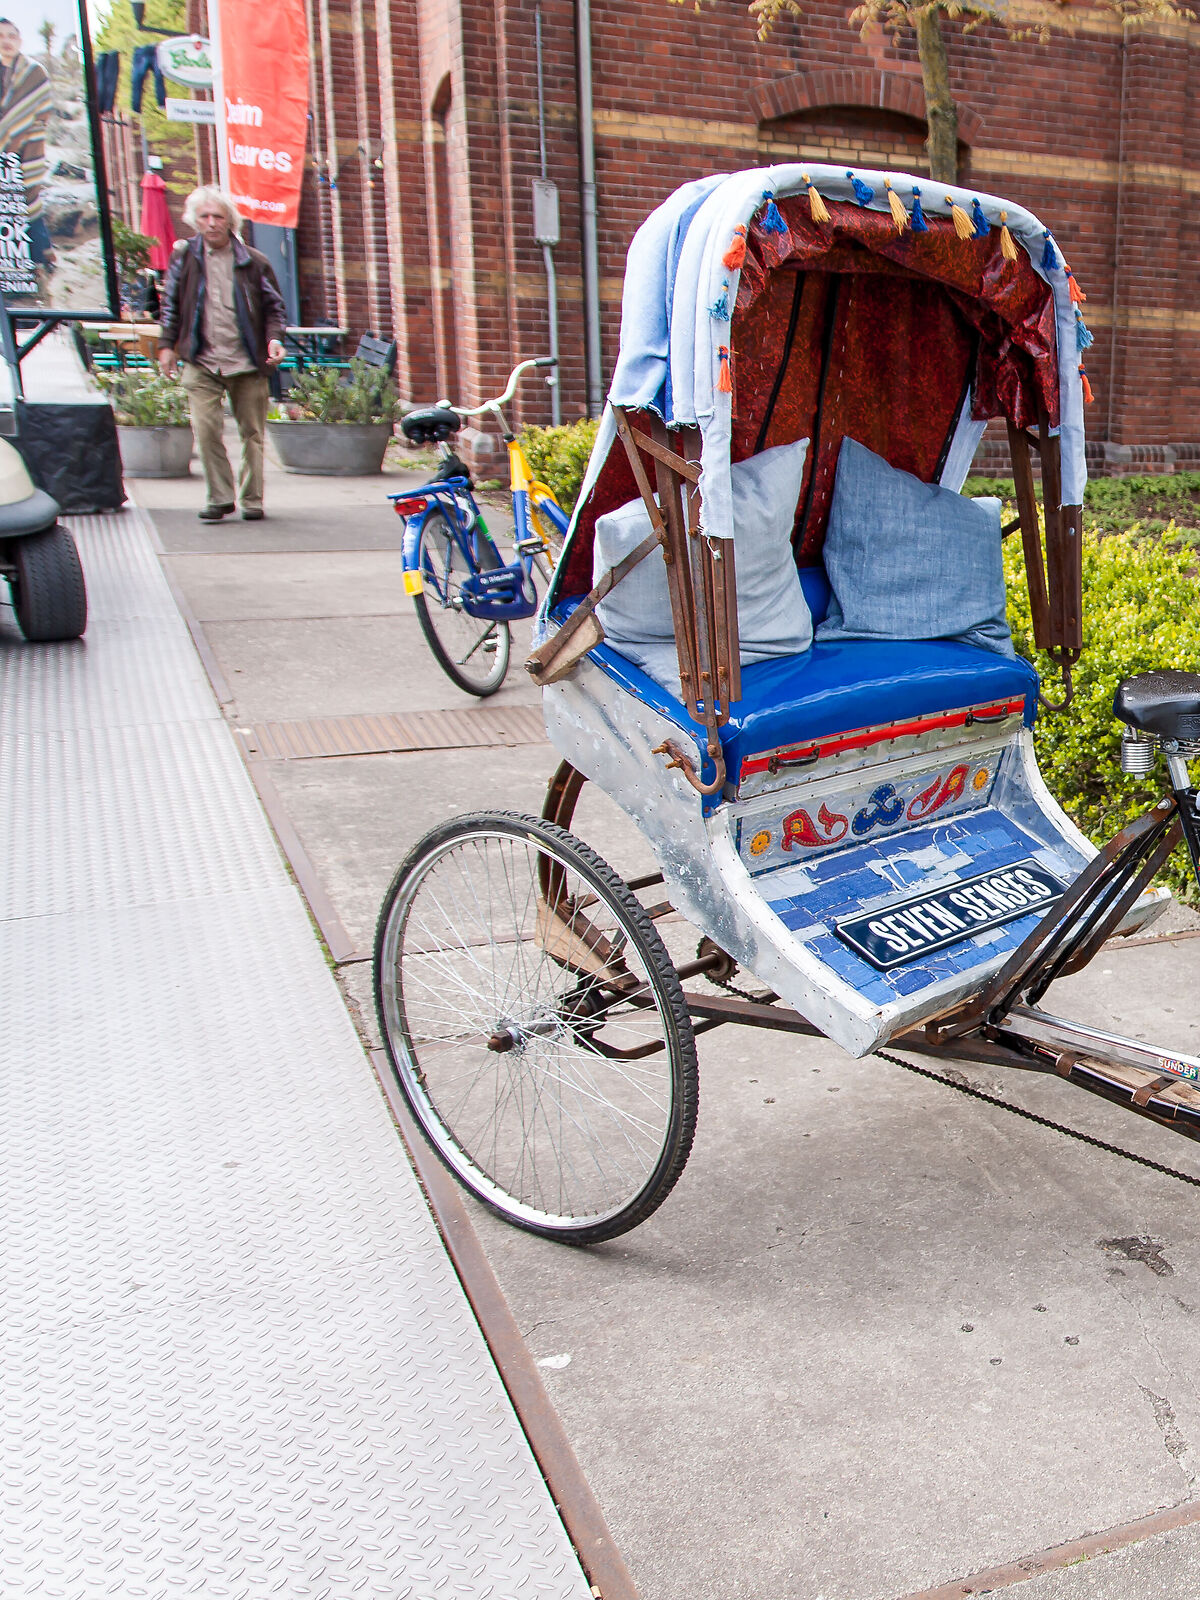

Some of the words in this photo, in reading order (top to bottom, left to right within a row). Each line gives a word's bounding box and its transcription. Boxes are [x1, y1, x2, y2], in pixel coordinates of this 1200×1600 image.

[868, 900, 966, 952] SEVEN
[950, 868, 1052, 922] SENSES
[1159, 1057, 1196, 1077] SUNDER
